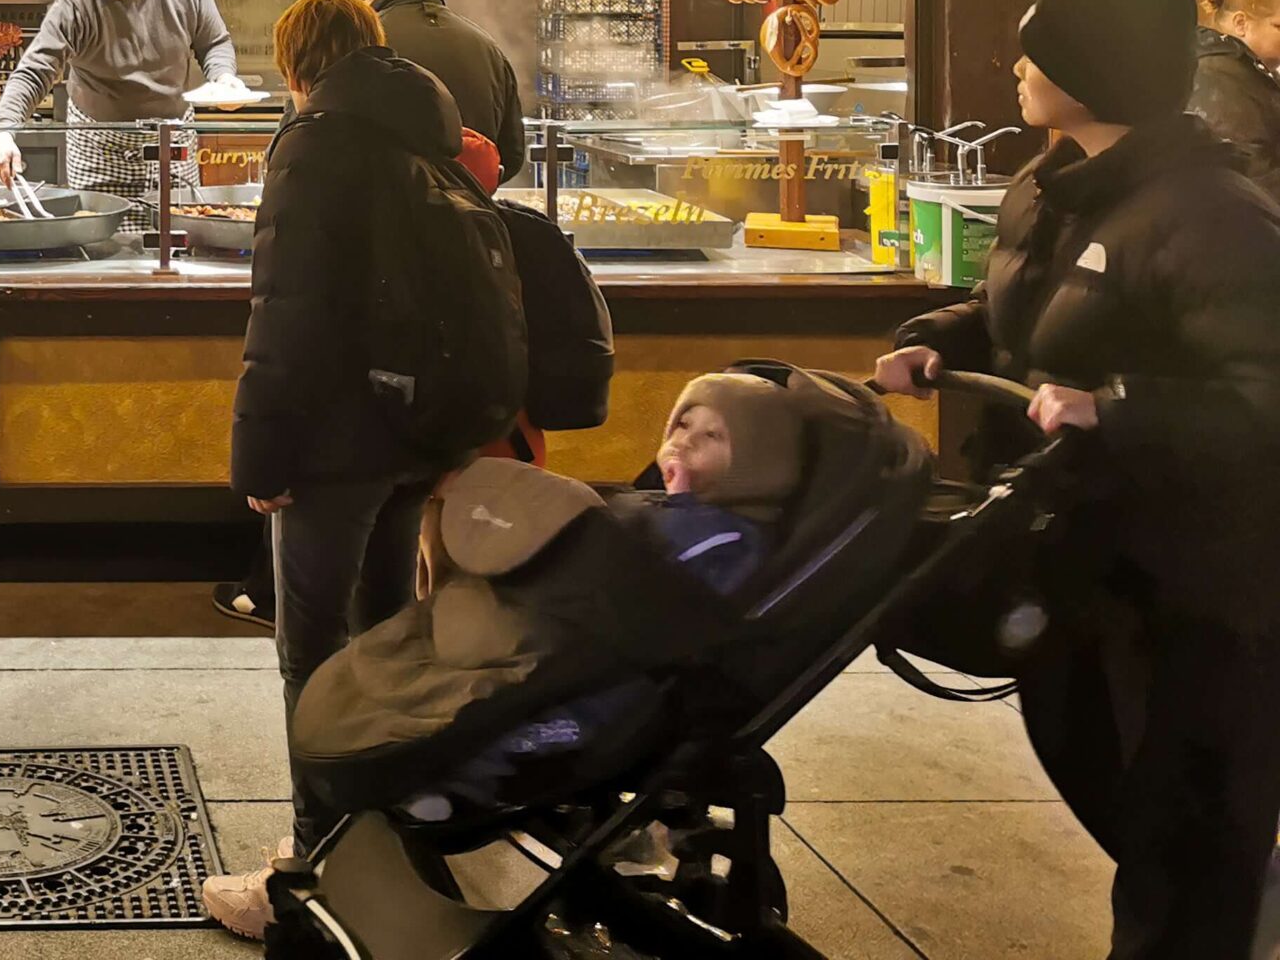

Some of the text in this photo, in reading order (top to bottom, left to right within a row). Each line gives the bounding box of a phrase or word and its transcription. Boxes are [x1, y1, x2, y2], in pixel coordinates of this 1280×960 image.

[197, 148, 266, 168] Curryw
[680, 156, 797, 180] Pommes
[573, 191, 705, 226] Brezeln
